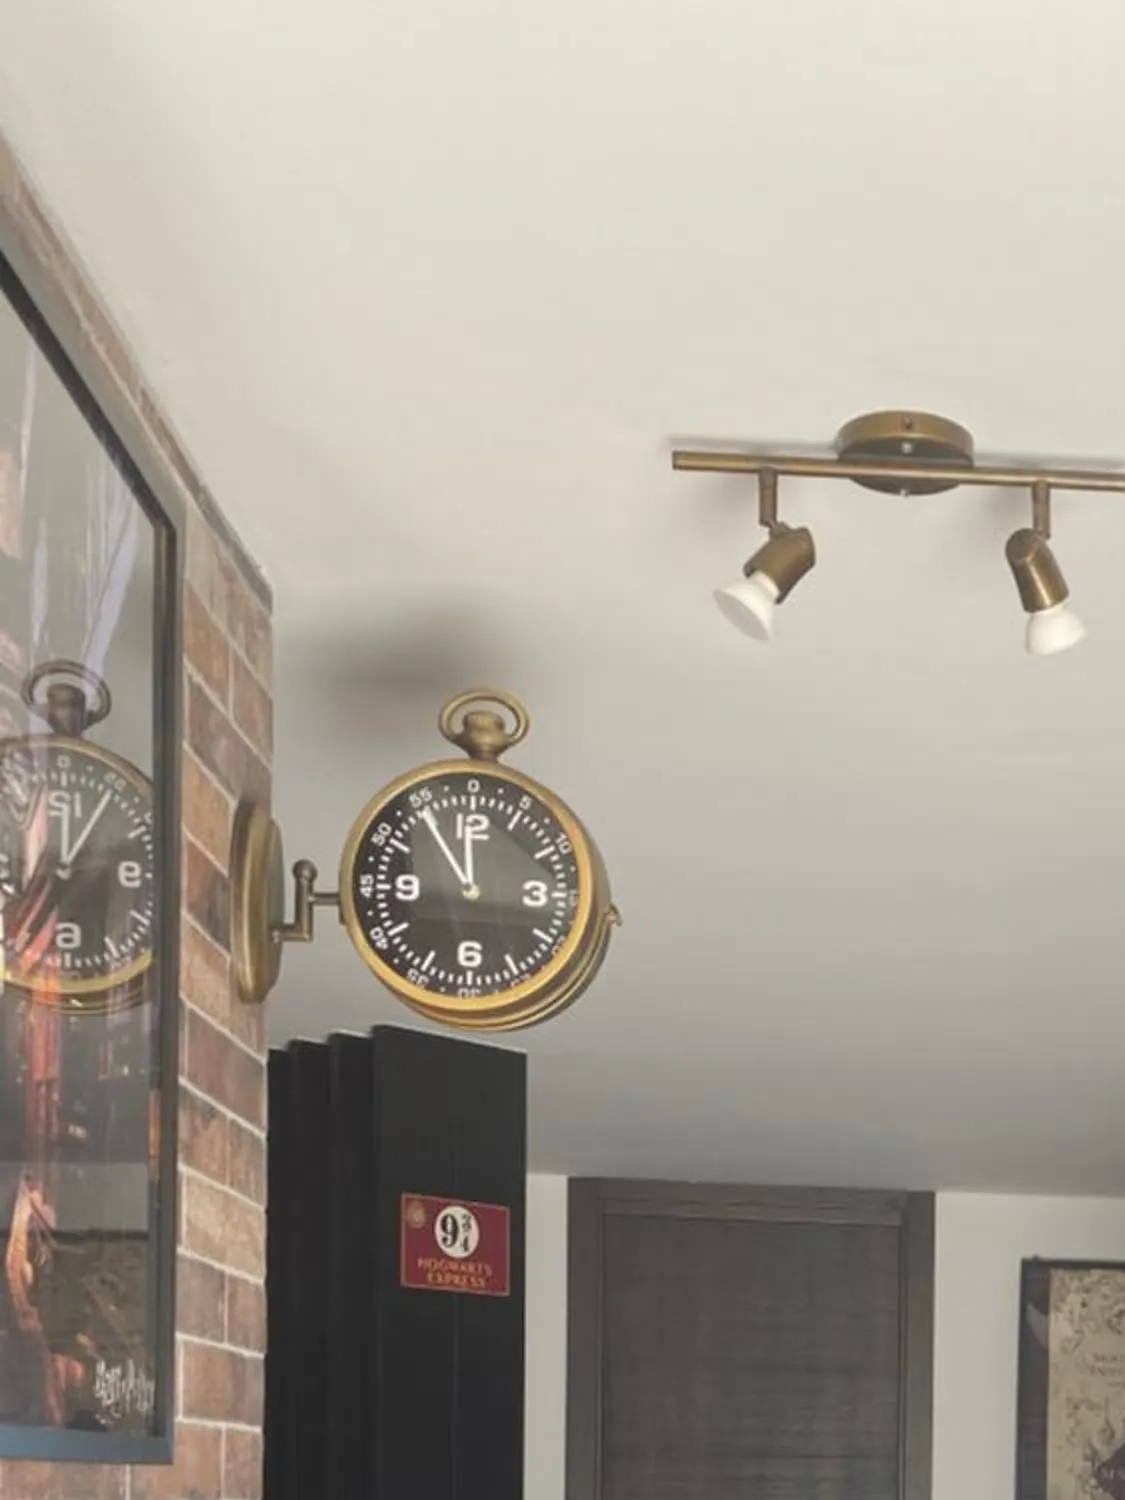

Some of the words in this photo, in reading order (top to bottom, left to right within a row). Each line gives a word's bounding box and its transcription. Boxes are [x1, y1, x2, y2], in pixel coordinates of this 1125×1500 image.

[409, 787, 432, 808] 55
[467, 778, 480, 793] 0
[519, 795, 532, 810] 5
[371, 822, 392, 846] 50
[455, 813, 490, 841] 12
[556, 832, 572, 855] 10
[360, 874, 374, 898] 45
[395, 874, 420, 901] 9
[522, 880, 548, 908] 3
[369, 927, 389, 950] 40
[457, 940, 482, 968] 6
